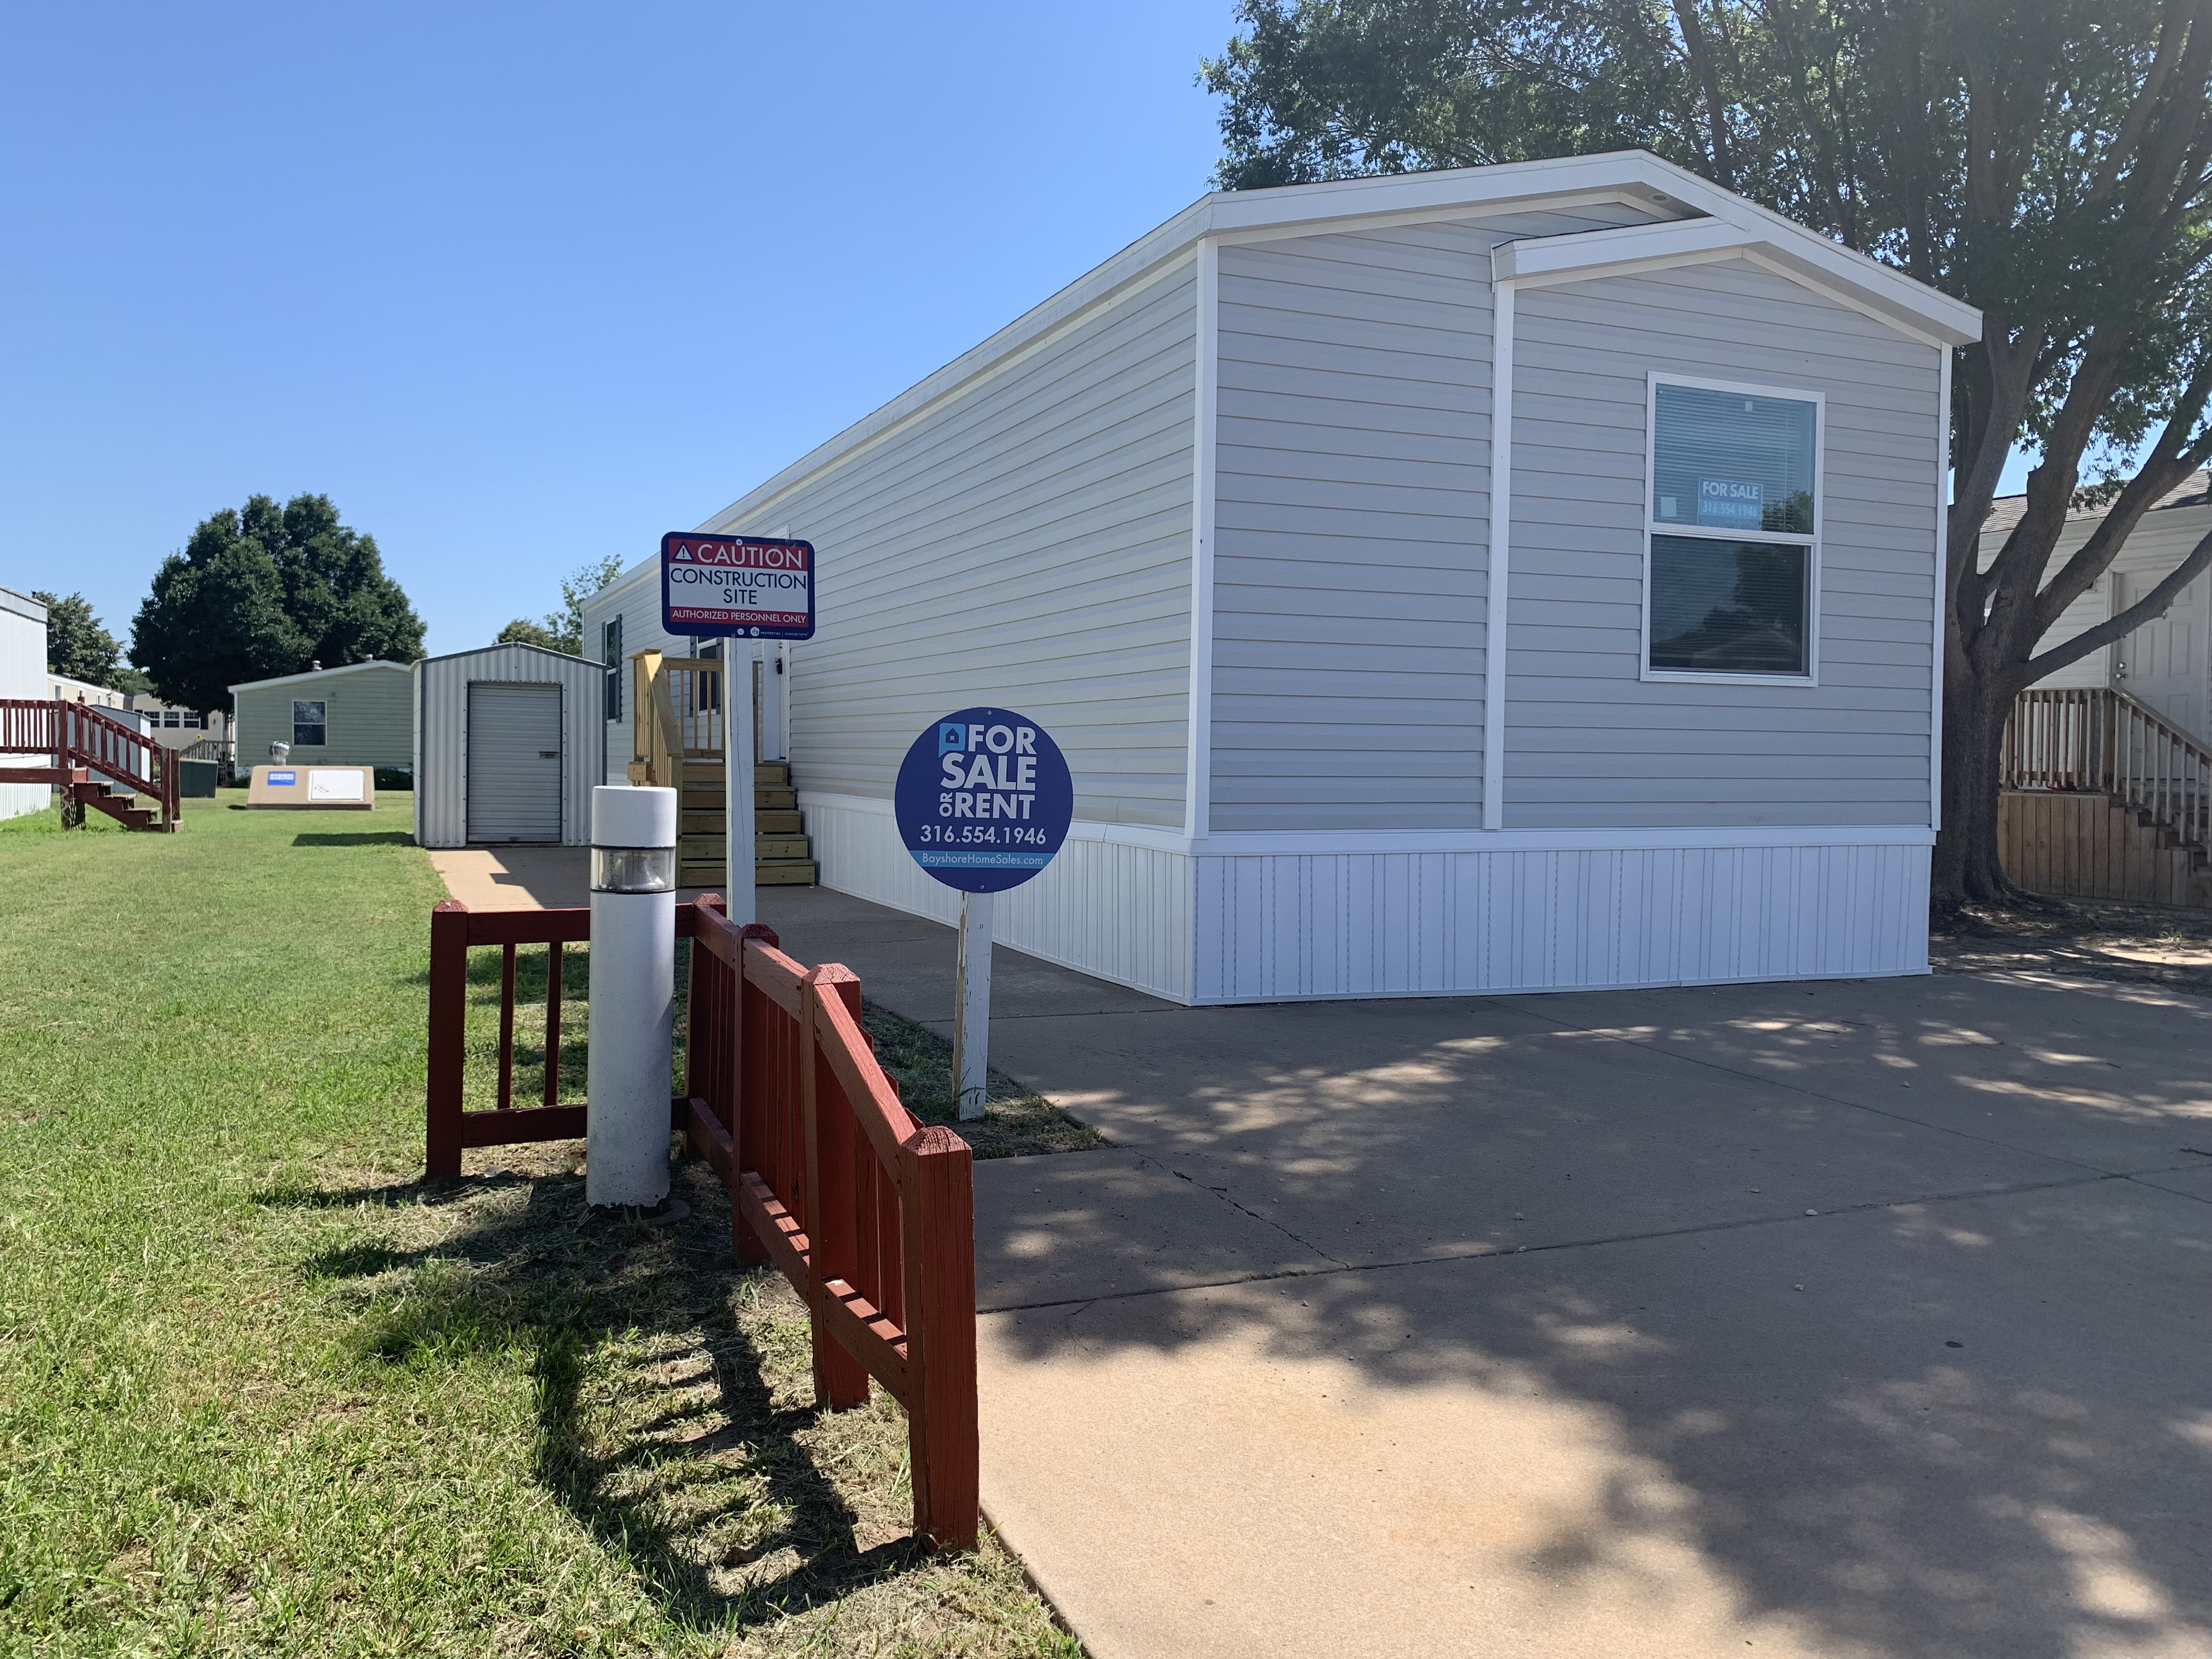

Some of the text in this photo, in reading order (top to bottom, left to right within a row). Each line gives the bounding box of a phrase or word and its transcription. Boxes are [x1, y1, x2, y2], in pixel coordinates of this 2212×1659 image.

[1703, 481, 1758, 499] FOR SALE
[1703, 501, 1757, 517] 316.554.1946
[698, 544, 802, 569] CAUTION
[670, 568, 806, 590] CONSTRUCTION
[723, 589, 757, 605] SITE
[672, 610, 806, 623] AUTHORIZED PERSONNEL ONLY
[968, 724, 1037, 754] FOR
[940, 752, 1037, 791] SALE
[939, 792, 952, 817] OR
[955, 792, 1035, 819] RENT
[920, 825, 1046, 844] 316.554.1946
[922, 853, 1042, 866] BayshoreHomeSales.com
